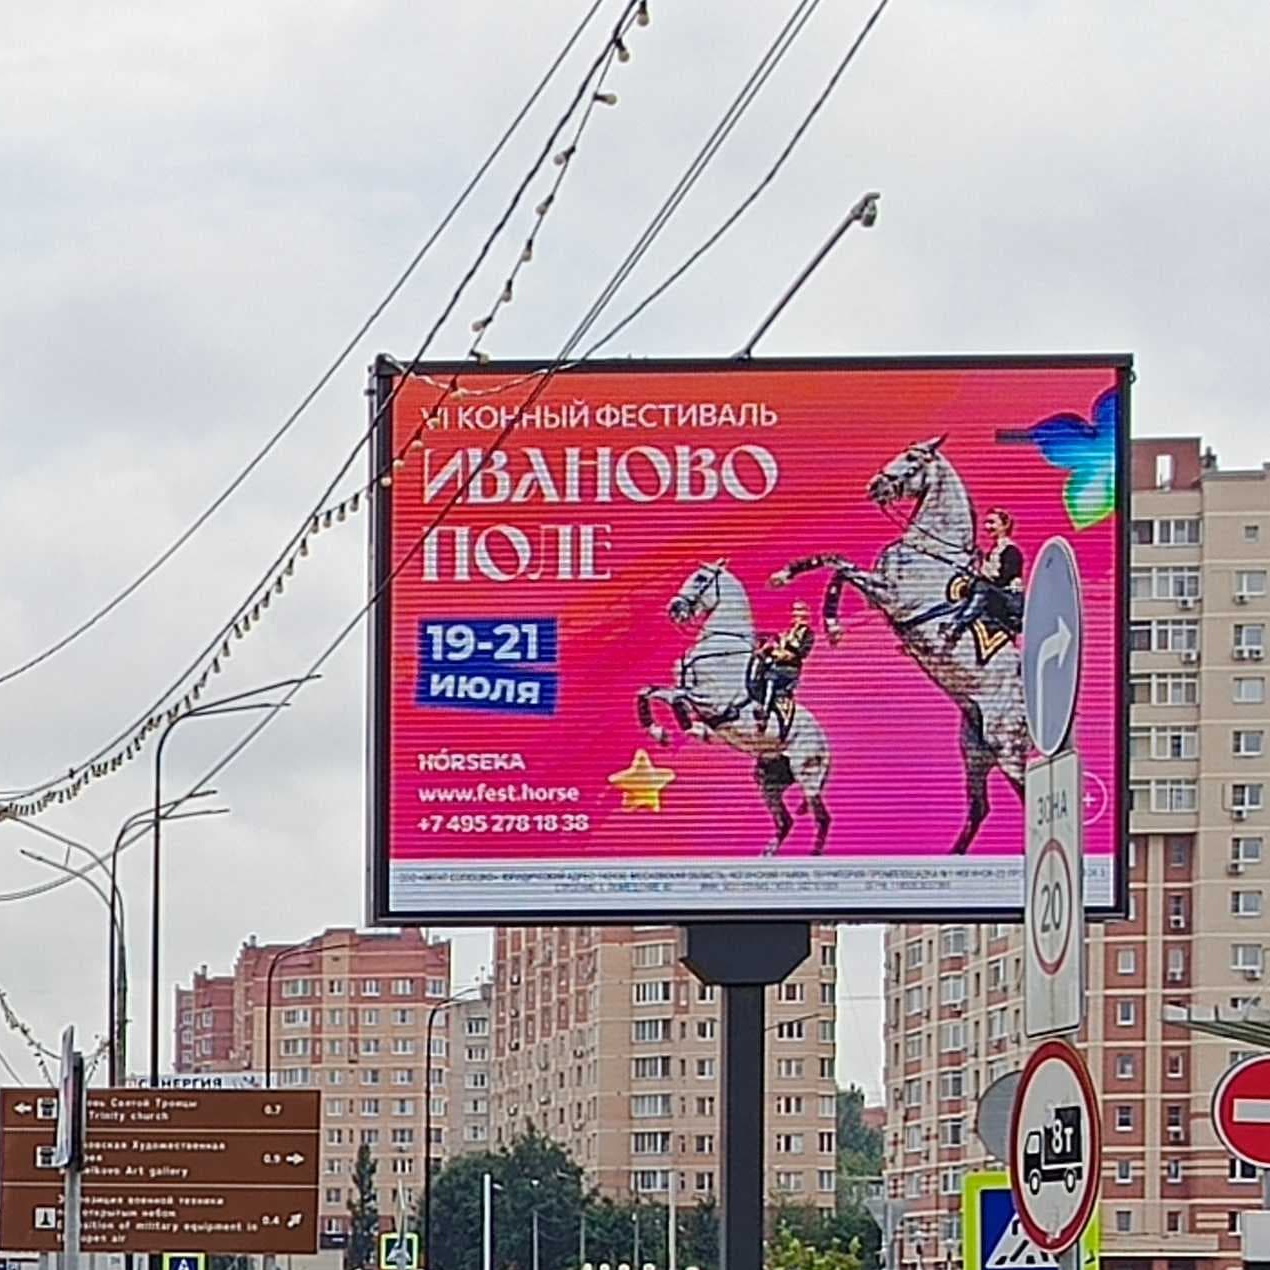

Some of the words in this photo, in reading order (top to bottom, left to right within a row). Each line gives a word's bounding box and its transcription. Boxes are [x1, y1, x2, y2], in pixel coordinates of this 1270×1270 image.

[460, 400, 589, 430] КОННЫЙ
[595, 402, 779, 430] ФЕСТИВАЛЬ
[422, 444, 780, 505] ИВАНОВО
[421, 523, 613, 582] ПОЛЕ
[426, 624, 538, 662] 19-21
[418, 783, 580, 802] www.fest.horse
[417, 814, 443, 833] +7
[446, 814, 487, 833] 495
[491, 814, 530, 832] 278
[533, 814, 558, 832] 18
[561, 813, 590, 832] 38
[1040, 881, 1062, 934] 20
[138, 1077, 222, 1088] СНЕРГИЯ
[89, 1109, 125, 1122] Trinity
[130, 1110, 169, 1121] church
[125, 1165, 144, 1176] Art
[148, 1165, 189, 1178] gallery
